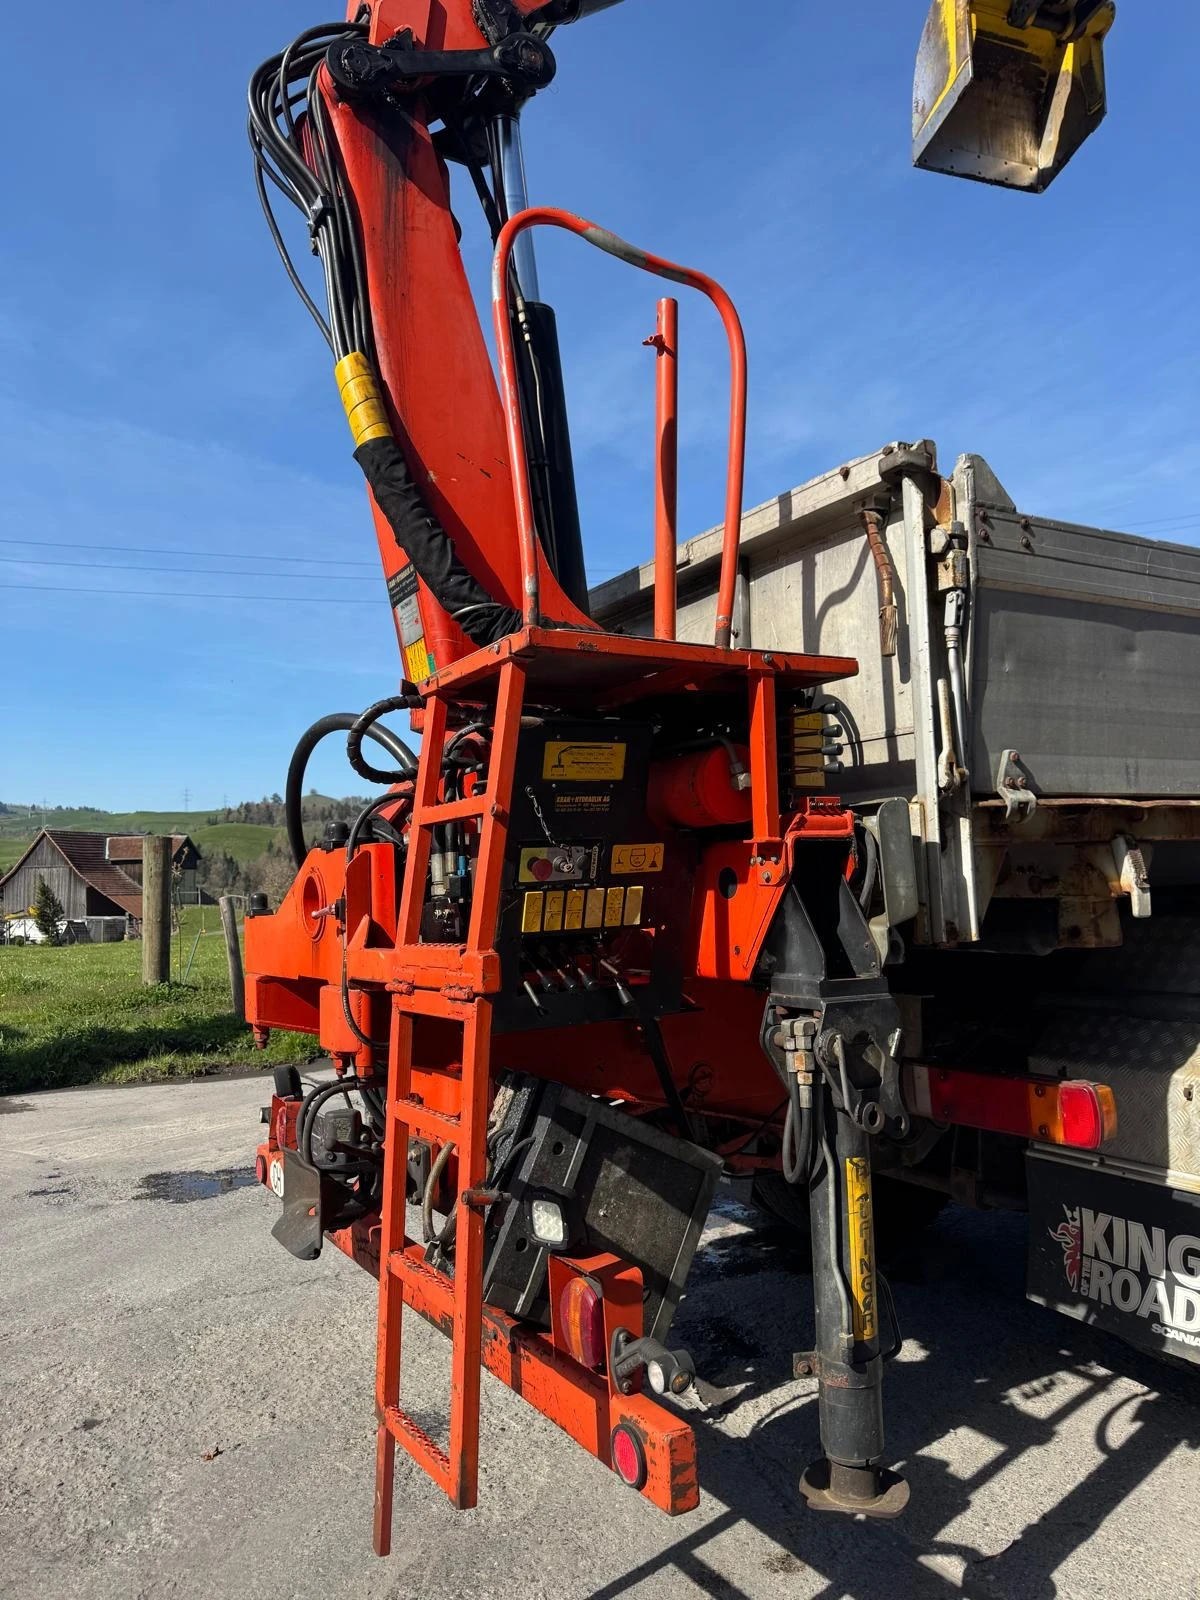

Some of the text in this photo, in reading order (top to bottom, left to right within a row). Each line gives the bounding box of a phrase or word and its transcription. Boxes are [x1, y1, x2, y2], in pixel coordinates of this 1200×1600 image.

[1081, 1207, 1200, 1289] KING
[1087, 1258, 1200, 1334] ROAD
[1151, 1323, 1200, 1347] SCANIA
